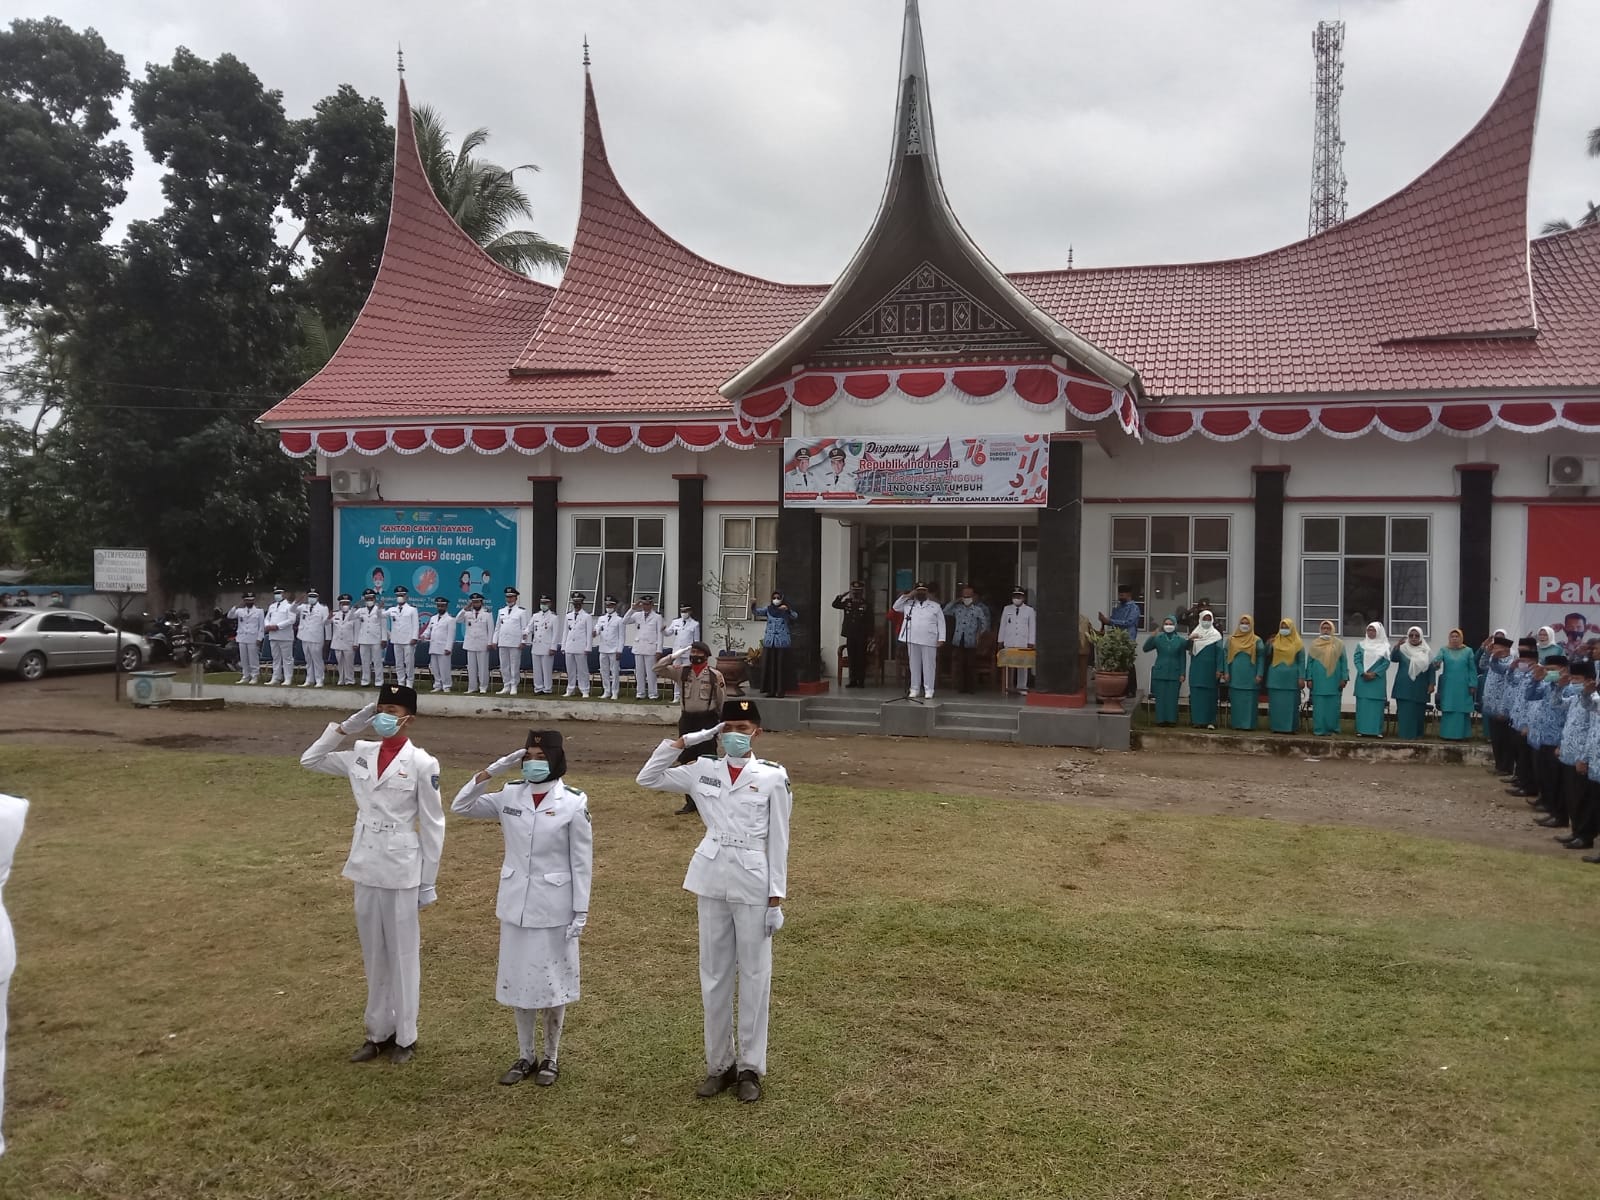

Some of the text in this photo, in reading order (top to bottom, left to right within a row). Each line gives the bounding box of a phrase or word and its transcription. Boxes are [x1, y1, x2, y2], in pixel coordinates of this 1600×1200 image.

[866, 442, 920, 458] Dirgahayu
[860, 459, 959, 471] Republik Indonesia
[942, 474, 984, 483] TANGGUH
[889, 484, 983, 492] INDONESIA TUMBUH
[380, 525, 411, 533] KANTOR
[413, 525, 440, 533] CAMAT
[358, 535, 496, 549] Ayo Lindungi Diri dan Keluarga
[379, 549, 474, 564] dari Covid-19 dengan:
